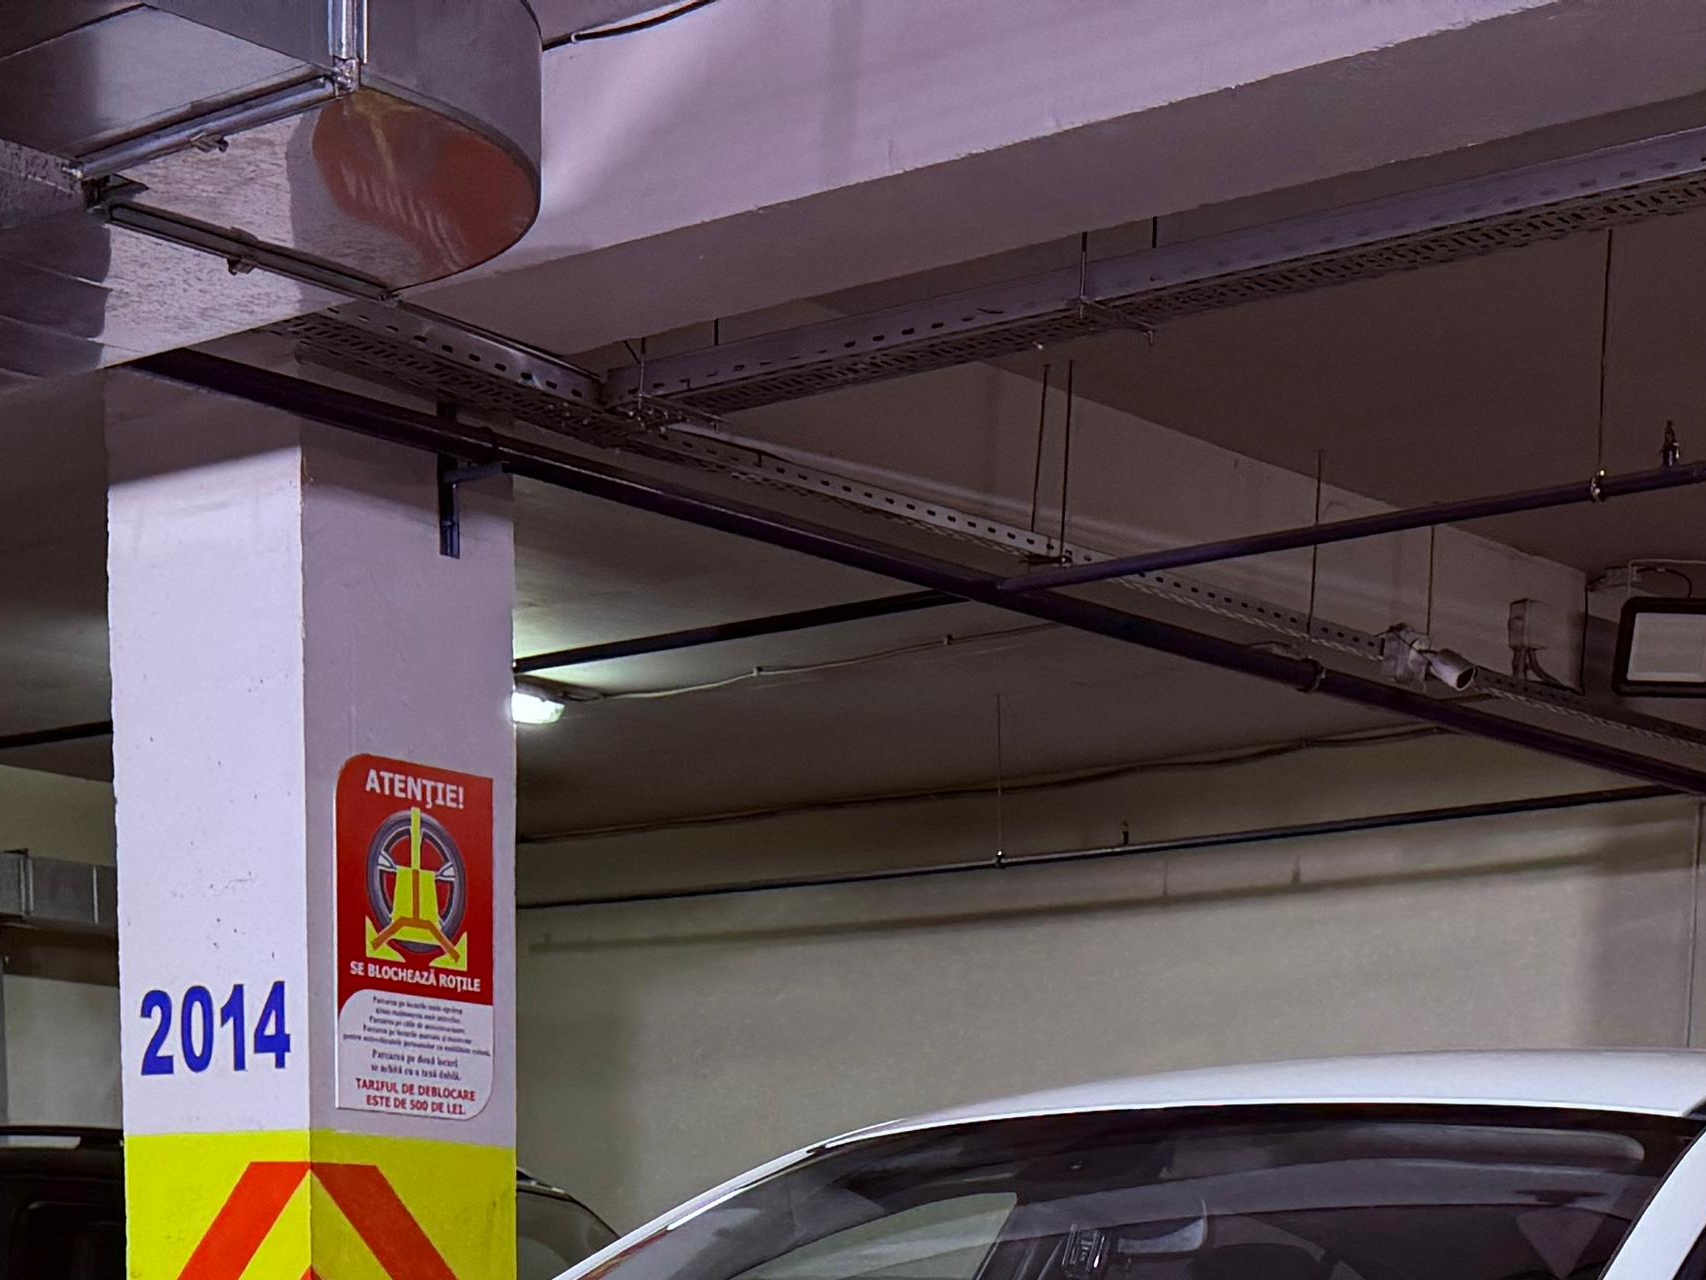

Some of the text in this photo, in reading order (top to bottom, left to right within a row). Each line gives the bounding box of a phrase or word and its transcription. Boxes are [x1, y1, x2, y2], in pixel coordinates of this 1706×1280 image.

[350, 961, 365, 976] SE
[367, 963, 437, 986] BLOCHEAZĂ
[140, 980, 291, 1075] 2014
[355, 1077, 476, 1102] TARIFUL DE DEBLOCARE
[366, 1094, 391, 1107] ESTE
[393, 1097, 407, 1110] DE
[431, 1101, 444, 1113] DE
